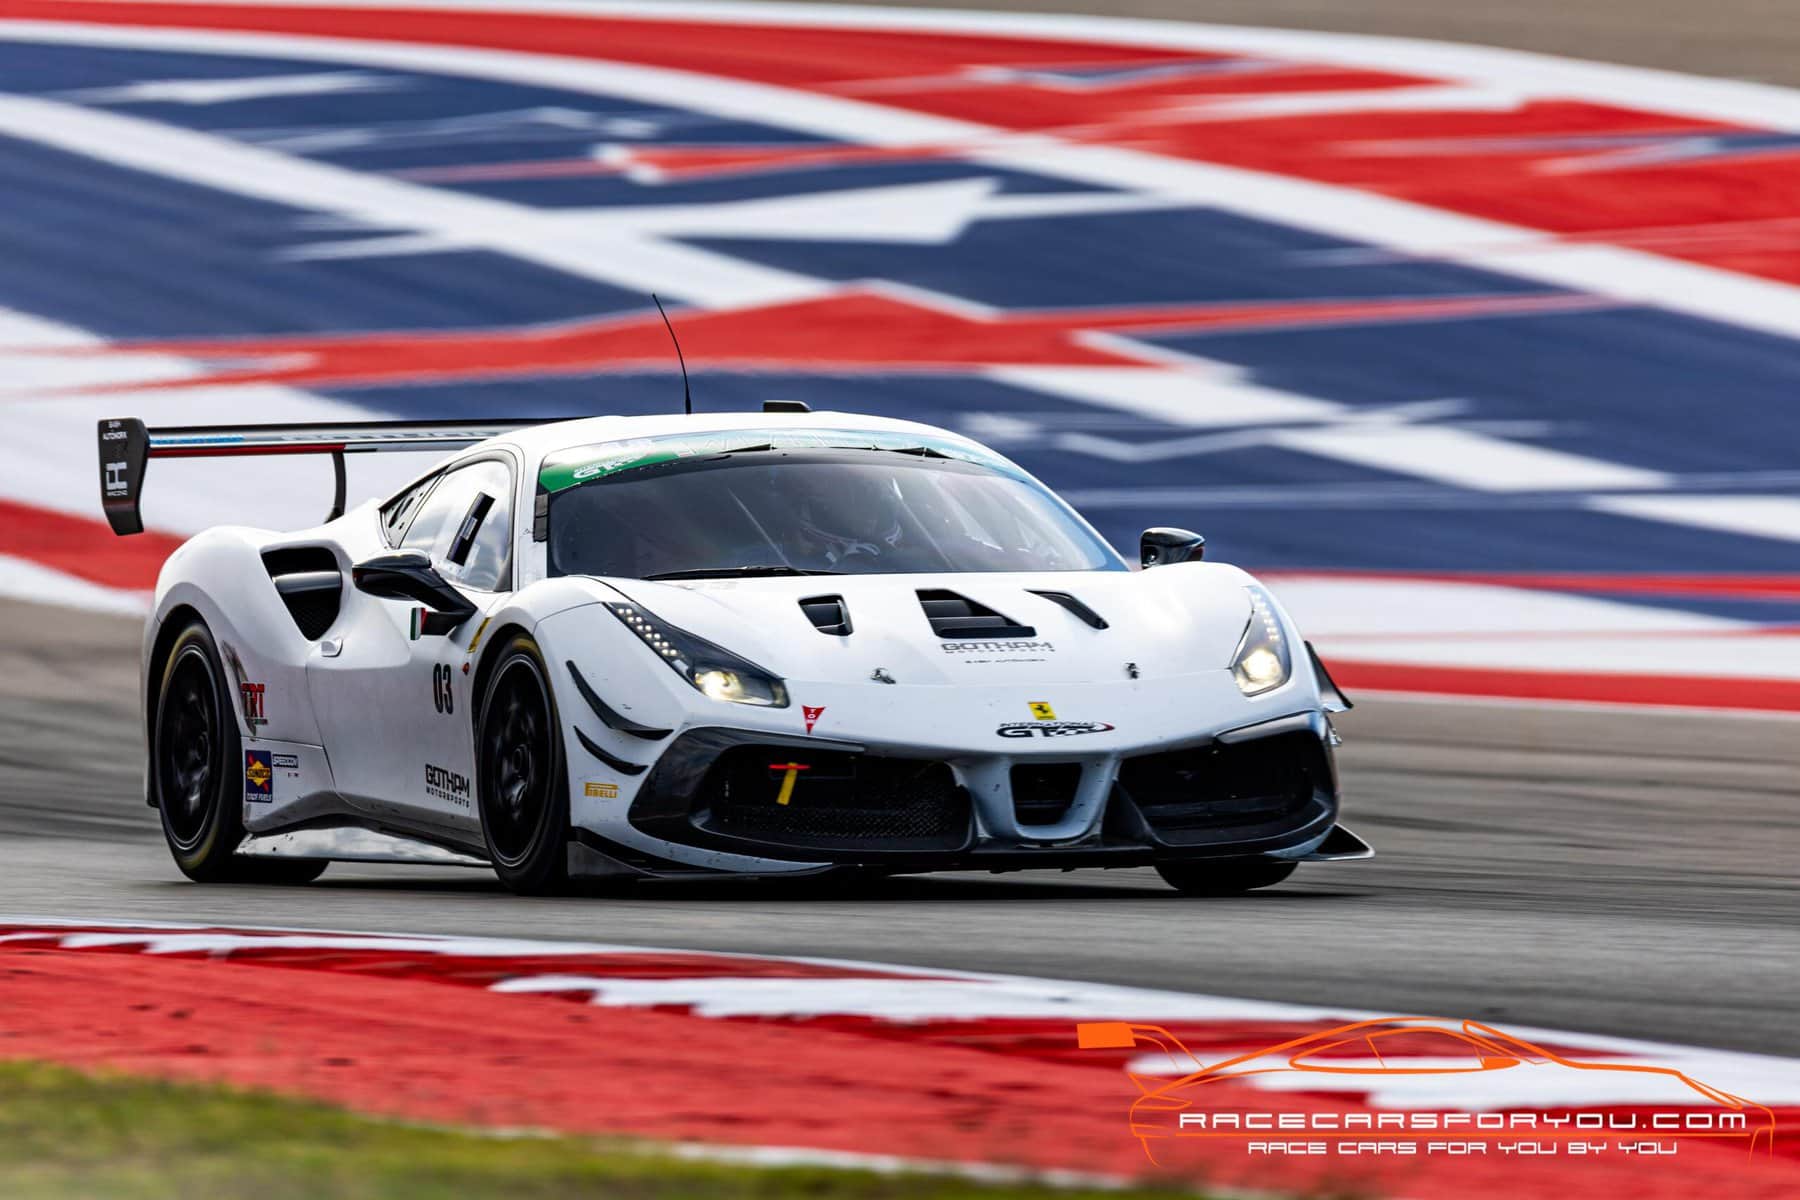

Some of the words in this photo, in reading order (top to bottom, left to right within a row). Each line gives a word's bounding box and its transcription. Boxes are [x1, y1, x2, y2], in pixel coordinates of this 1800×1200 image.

[941, 641, 1053, 651] GOTHAM
[433, 663, 453, 715] 03
[425, 763, 470, 799] GOTHAM
[426, 786, 470, 808] MOTORSPORTS
